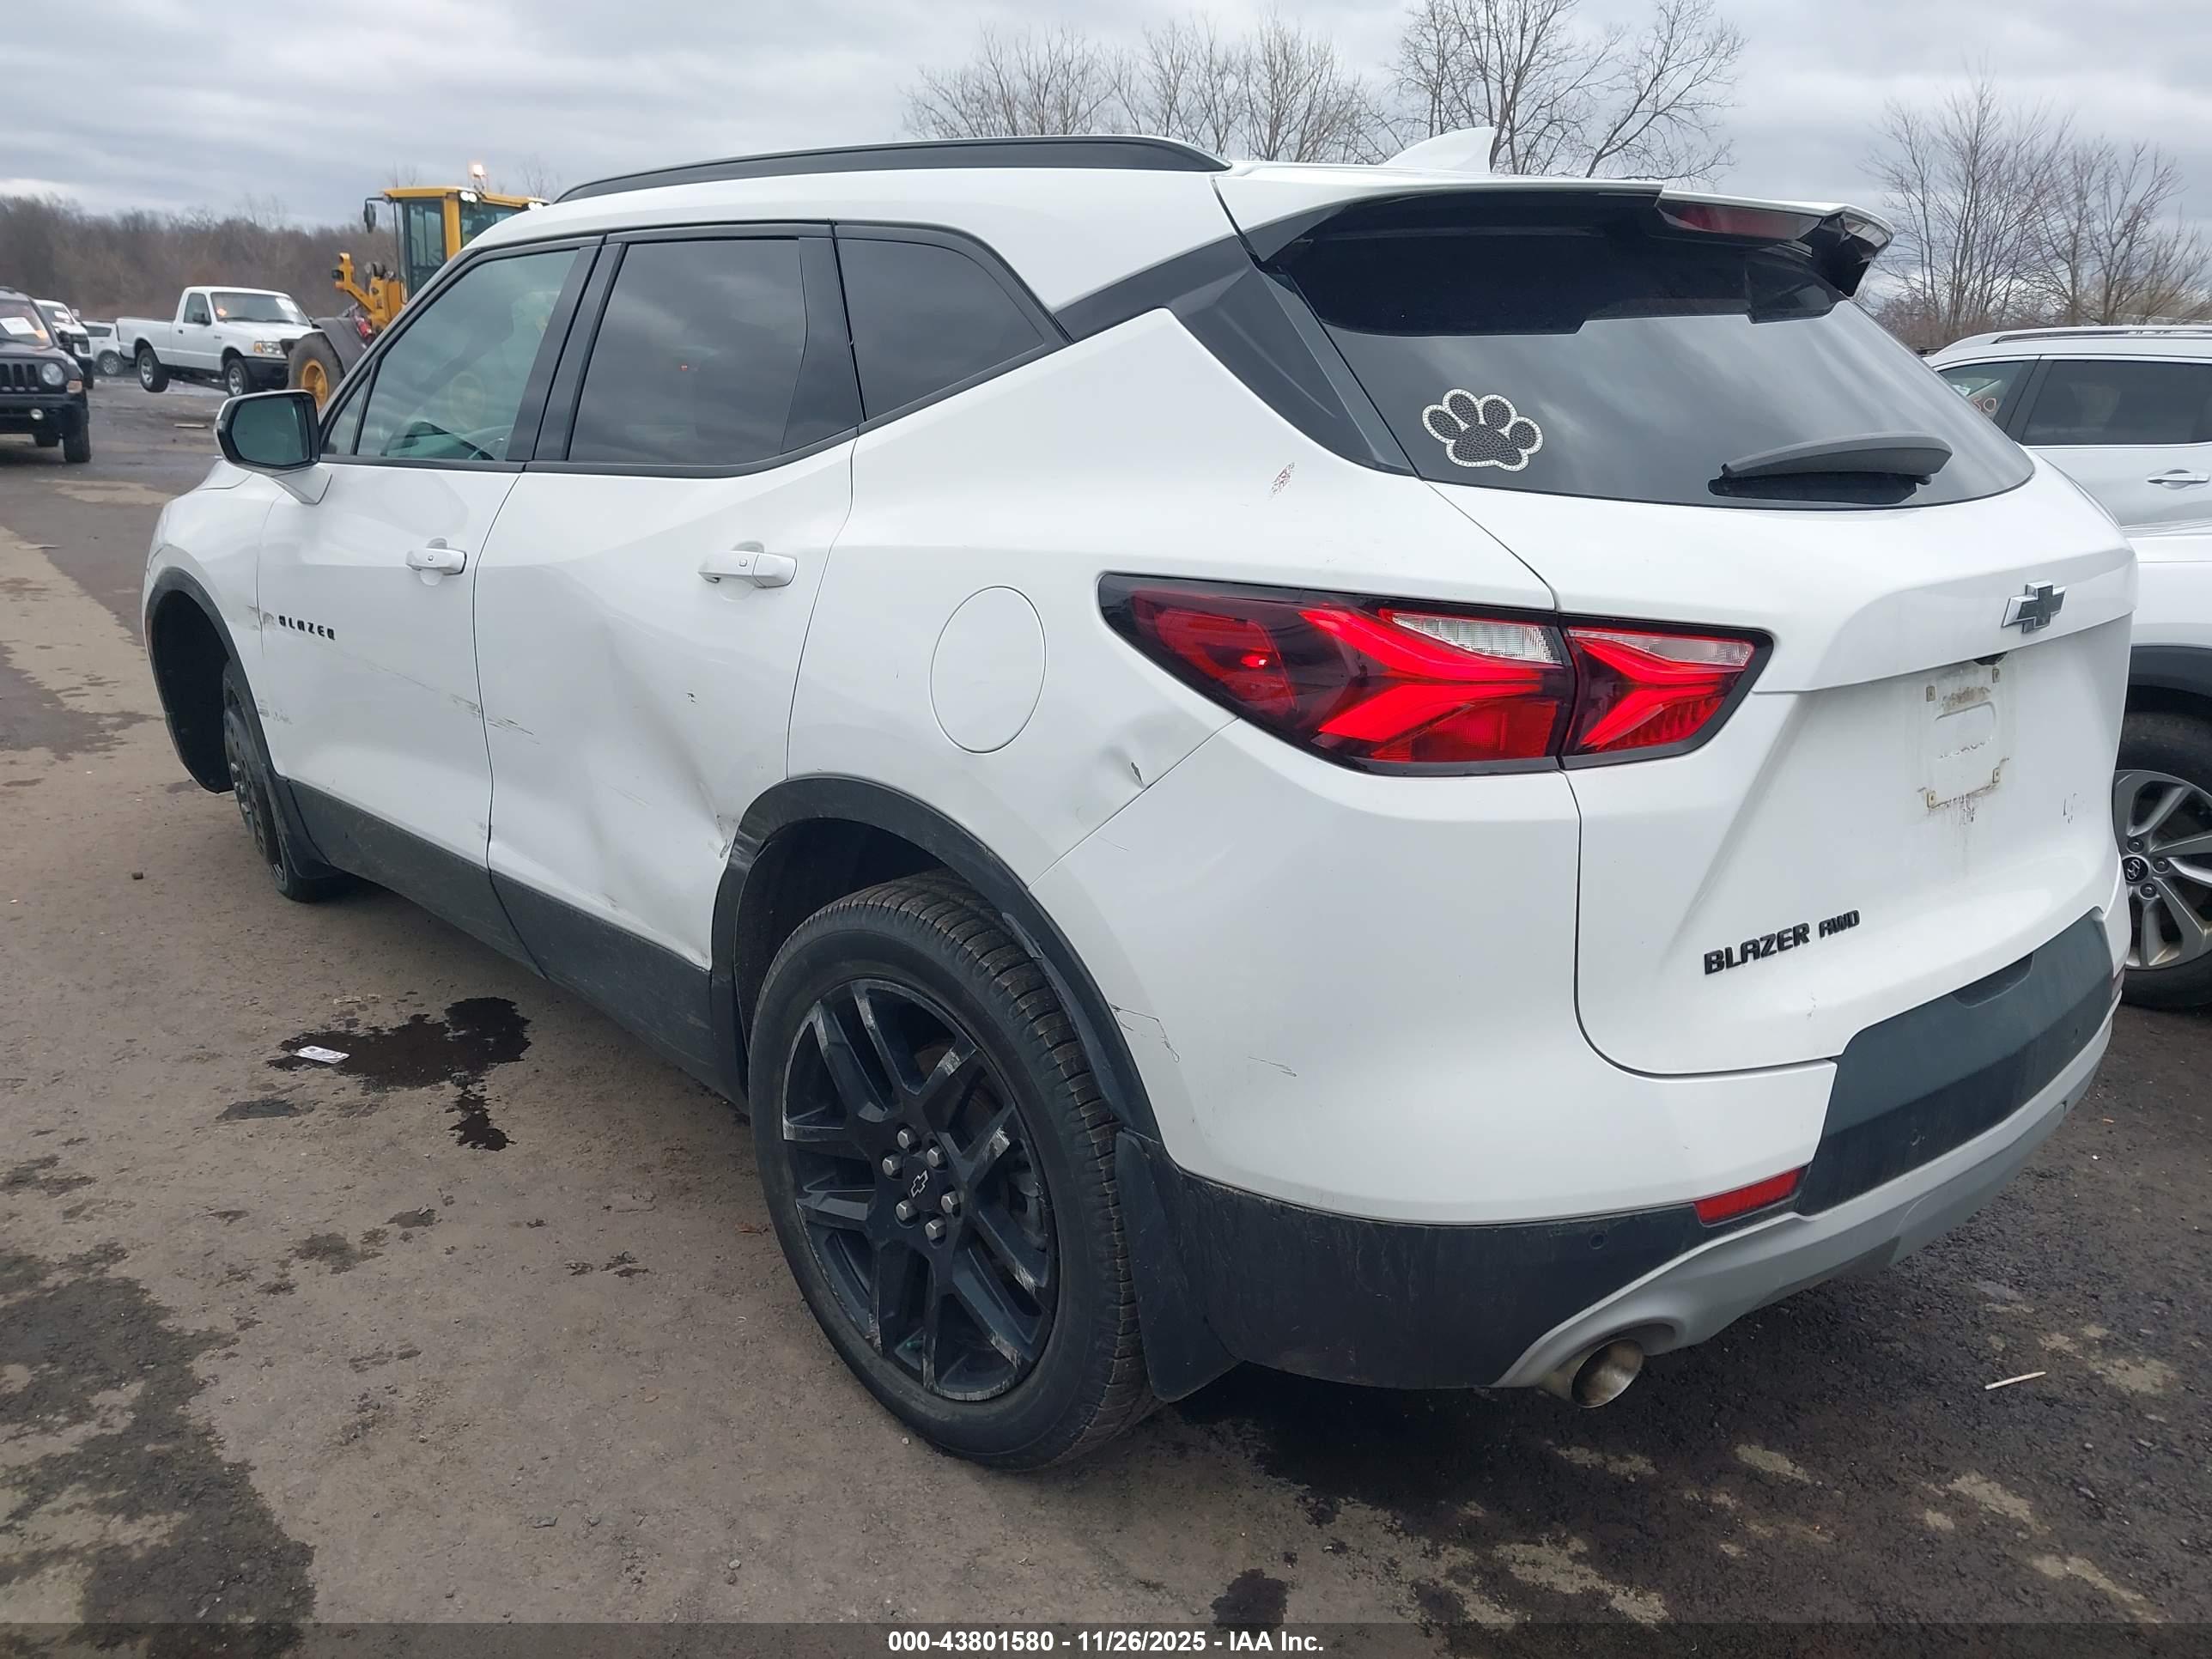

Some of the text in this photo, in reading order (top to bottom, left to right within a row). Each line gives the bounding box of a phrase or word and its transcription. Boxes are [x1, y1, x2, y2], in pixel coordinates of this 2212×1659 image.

[278, 615, 336, 641] BLAZER
[1704, 909, 1860, 975] BLAZER AWD
